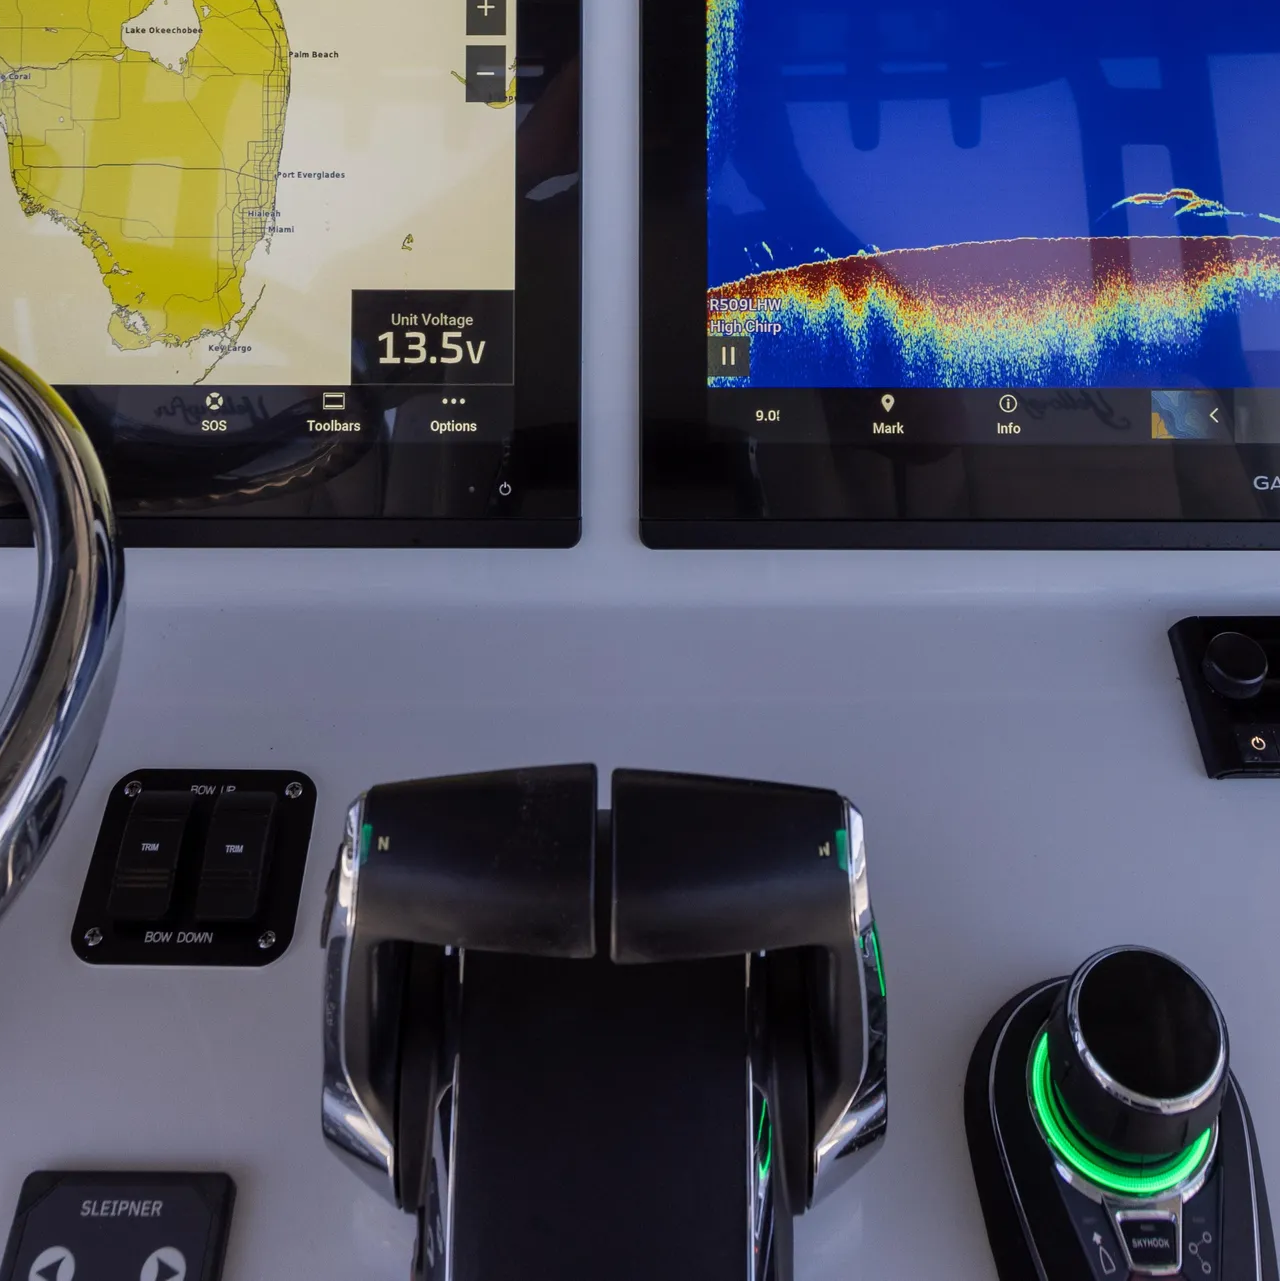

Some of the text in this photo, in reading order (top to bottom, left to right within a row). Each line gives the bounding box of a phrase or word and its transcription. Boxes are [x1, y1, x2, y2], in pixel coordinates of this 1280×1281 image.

[297, 171, 345, 180] Everglades
[709, 298, 782, 312] R509LHW
[391, 313, 474, 328] Unit Voltage
[710, 320, 782, 335] High Chirp
[208, 345, 252, 353] Key Largo
[201, 420, 227, 432] SOS
[307, 420, 361, 432] Toolbars
[430, 420, 477, 434] Options
[872, 422, 904, 434] Mark
[997, 422, 1021, 434] Info
[190, 784, 217, 795] BOW
[141, 843, 159, 851] TRIM
[225, 845, 243, 853] TRIM
[378, 836, 390, 851] N
[144, 932, 213, 943] BOW DOWN
[80, 1200, 163, 1217] SLEIPNER
[1132, 1238, 1170, 1249] SKYHOOK
